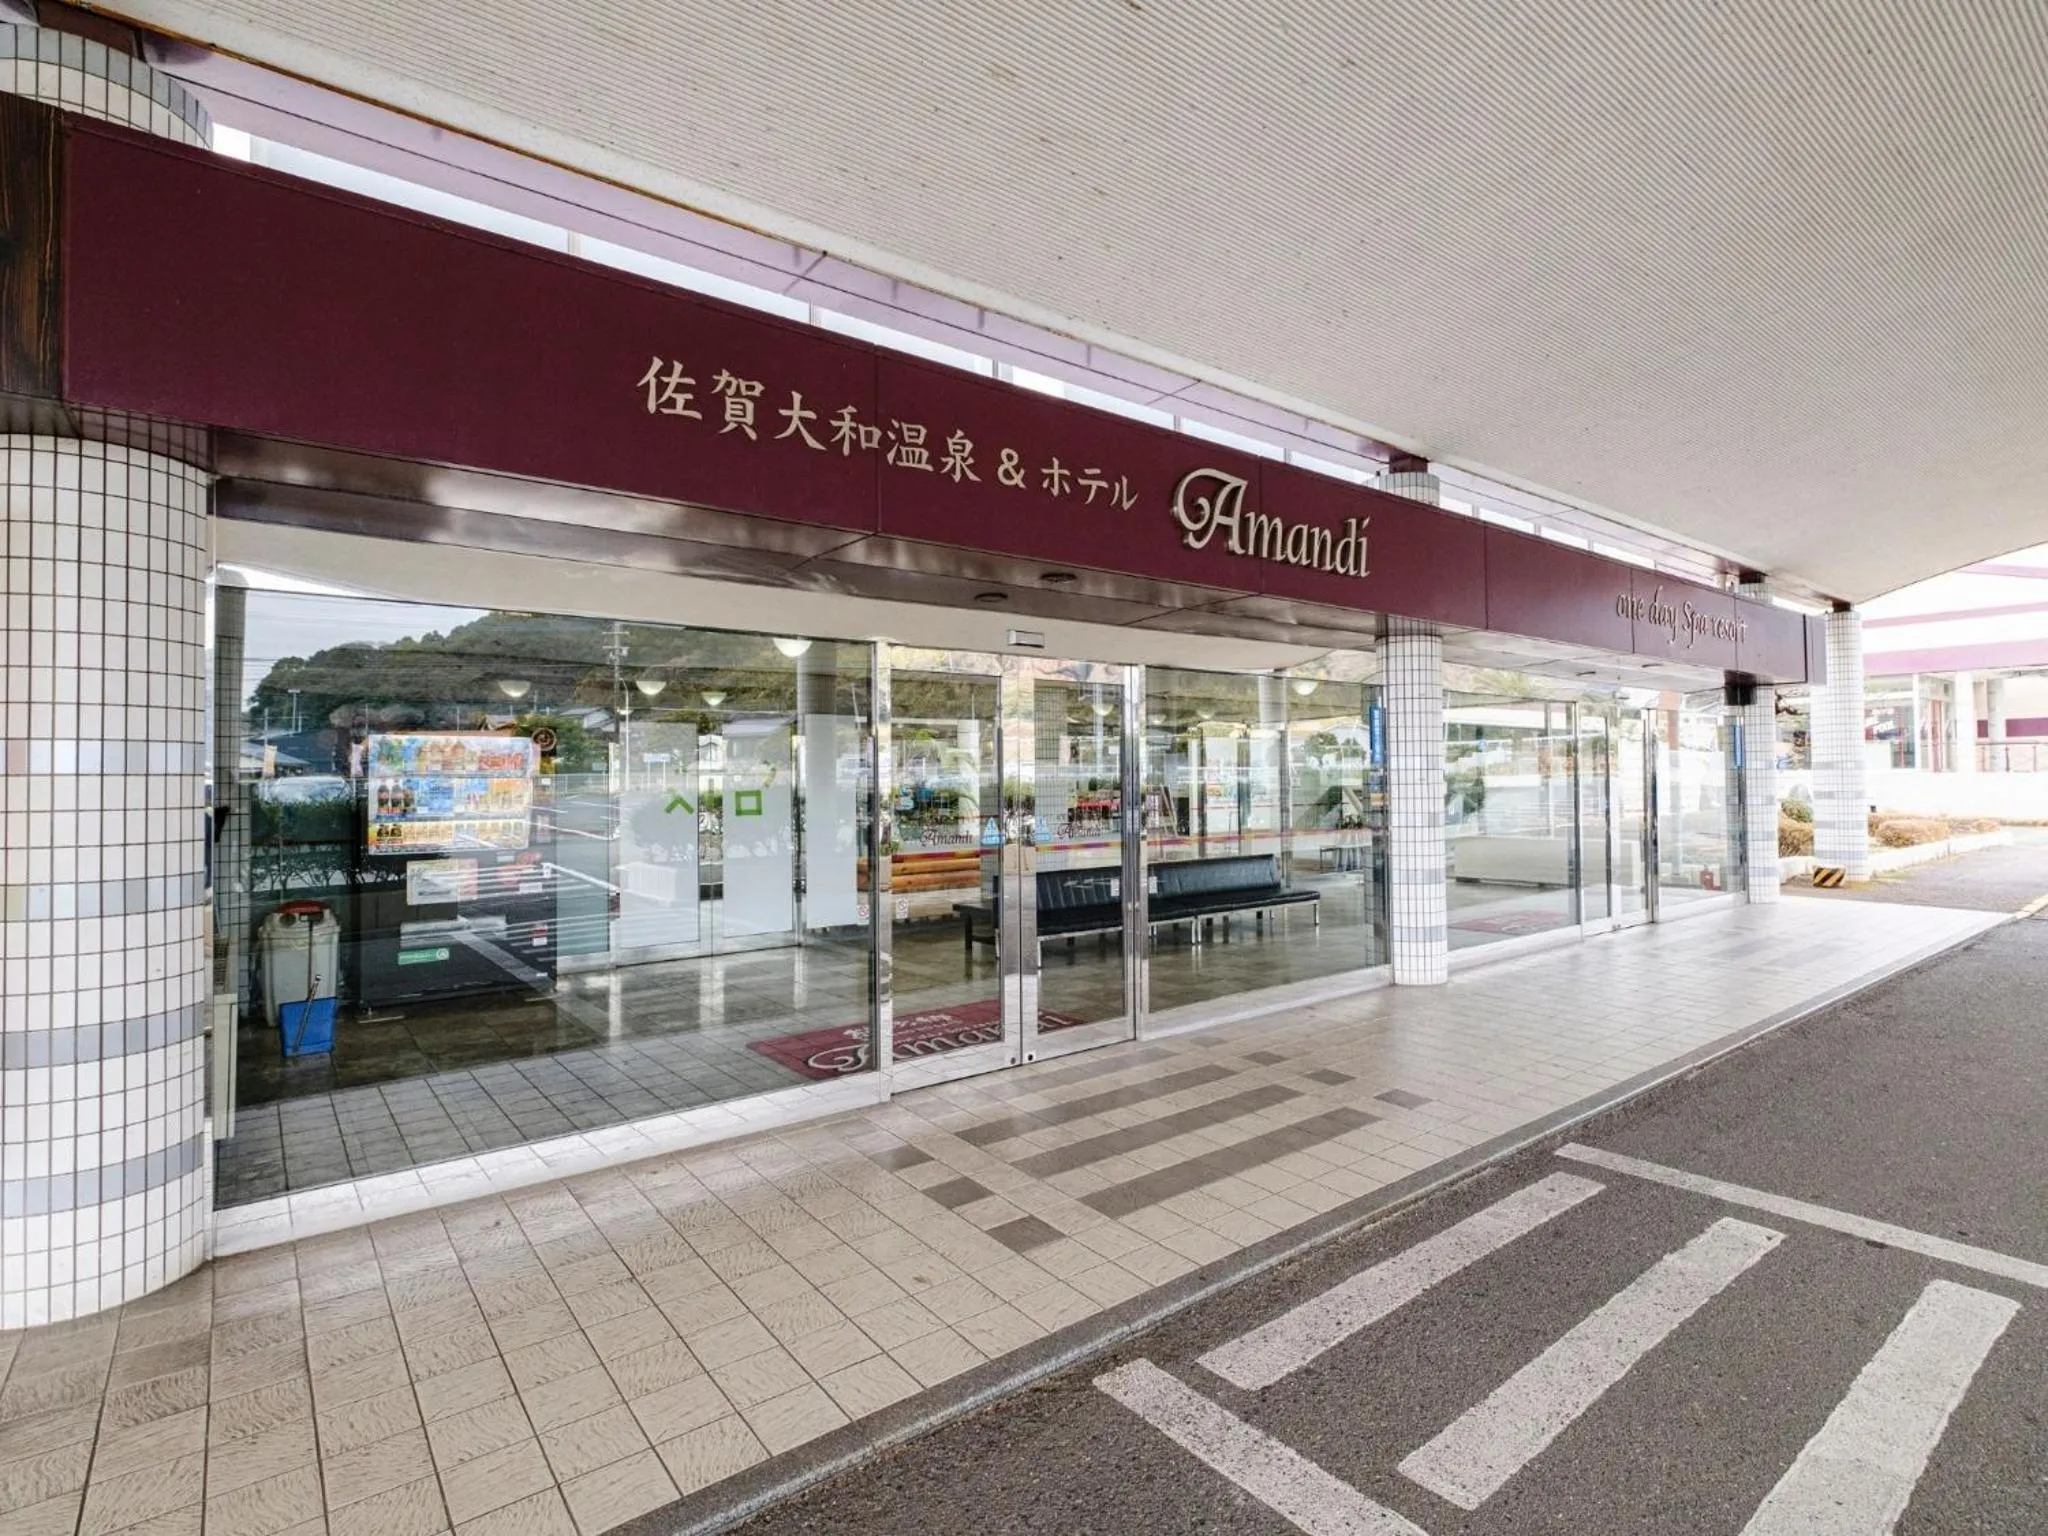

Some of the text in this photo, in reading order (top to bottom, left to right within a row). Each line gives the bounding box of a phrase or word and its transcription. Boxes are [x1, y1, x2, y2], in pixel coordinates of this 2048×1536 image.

[637, 356, 1371, 578] 佐賀大和温泉 & ホテル Amandi
[1616, 585, 1748, 649] one day Spa resort
